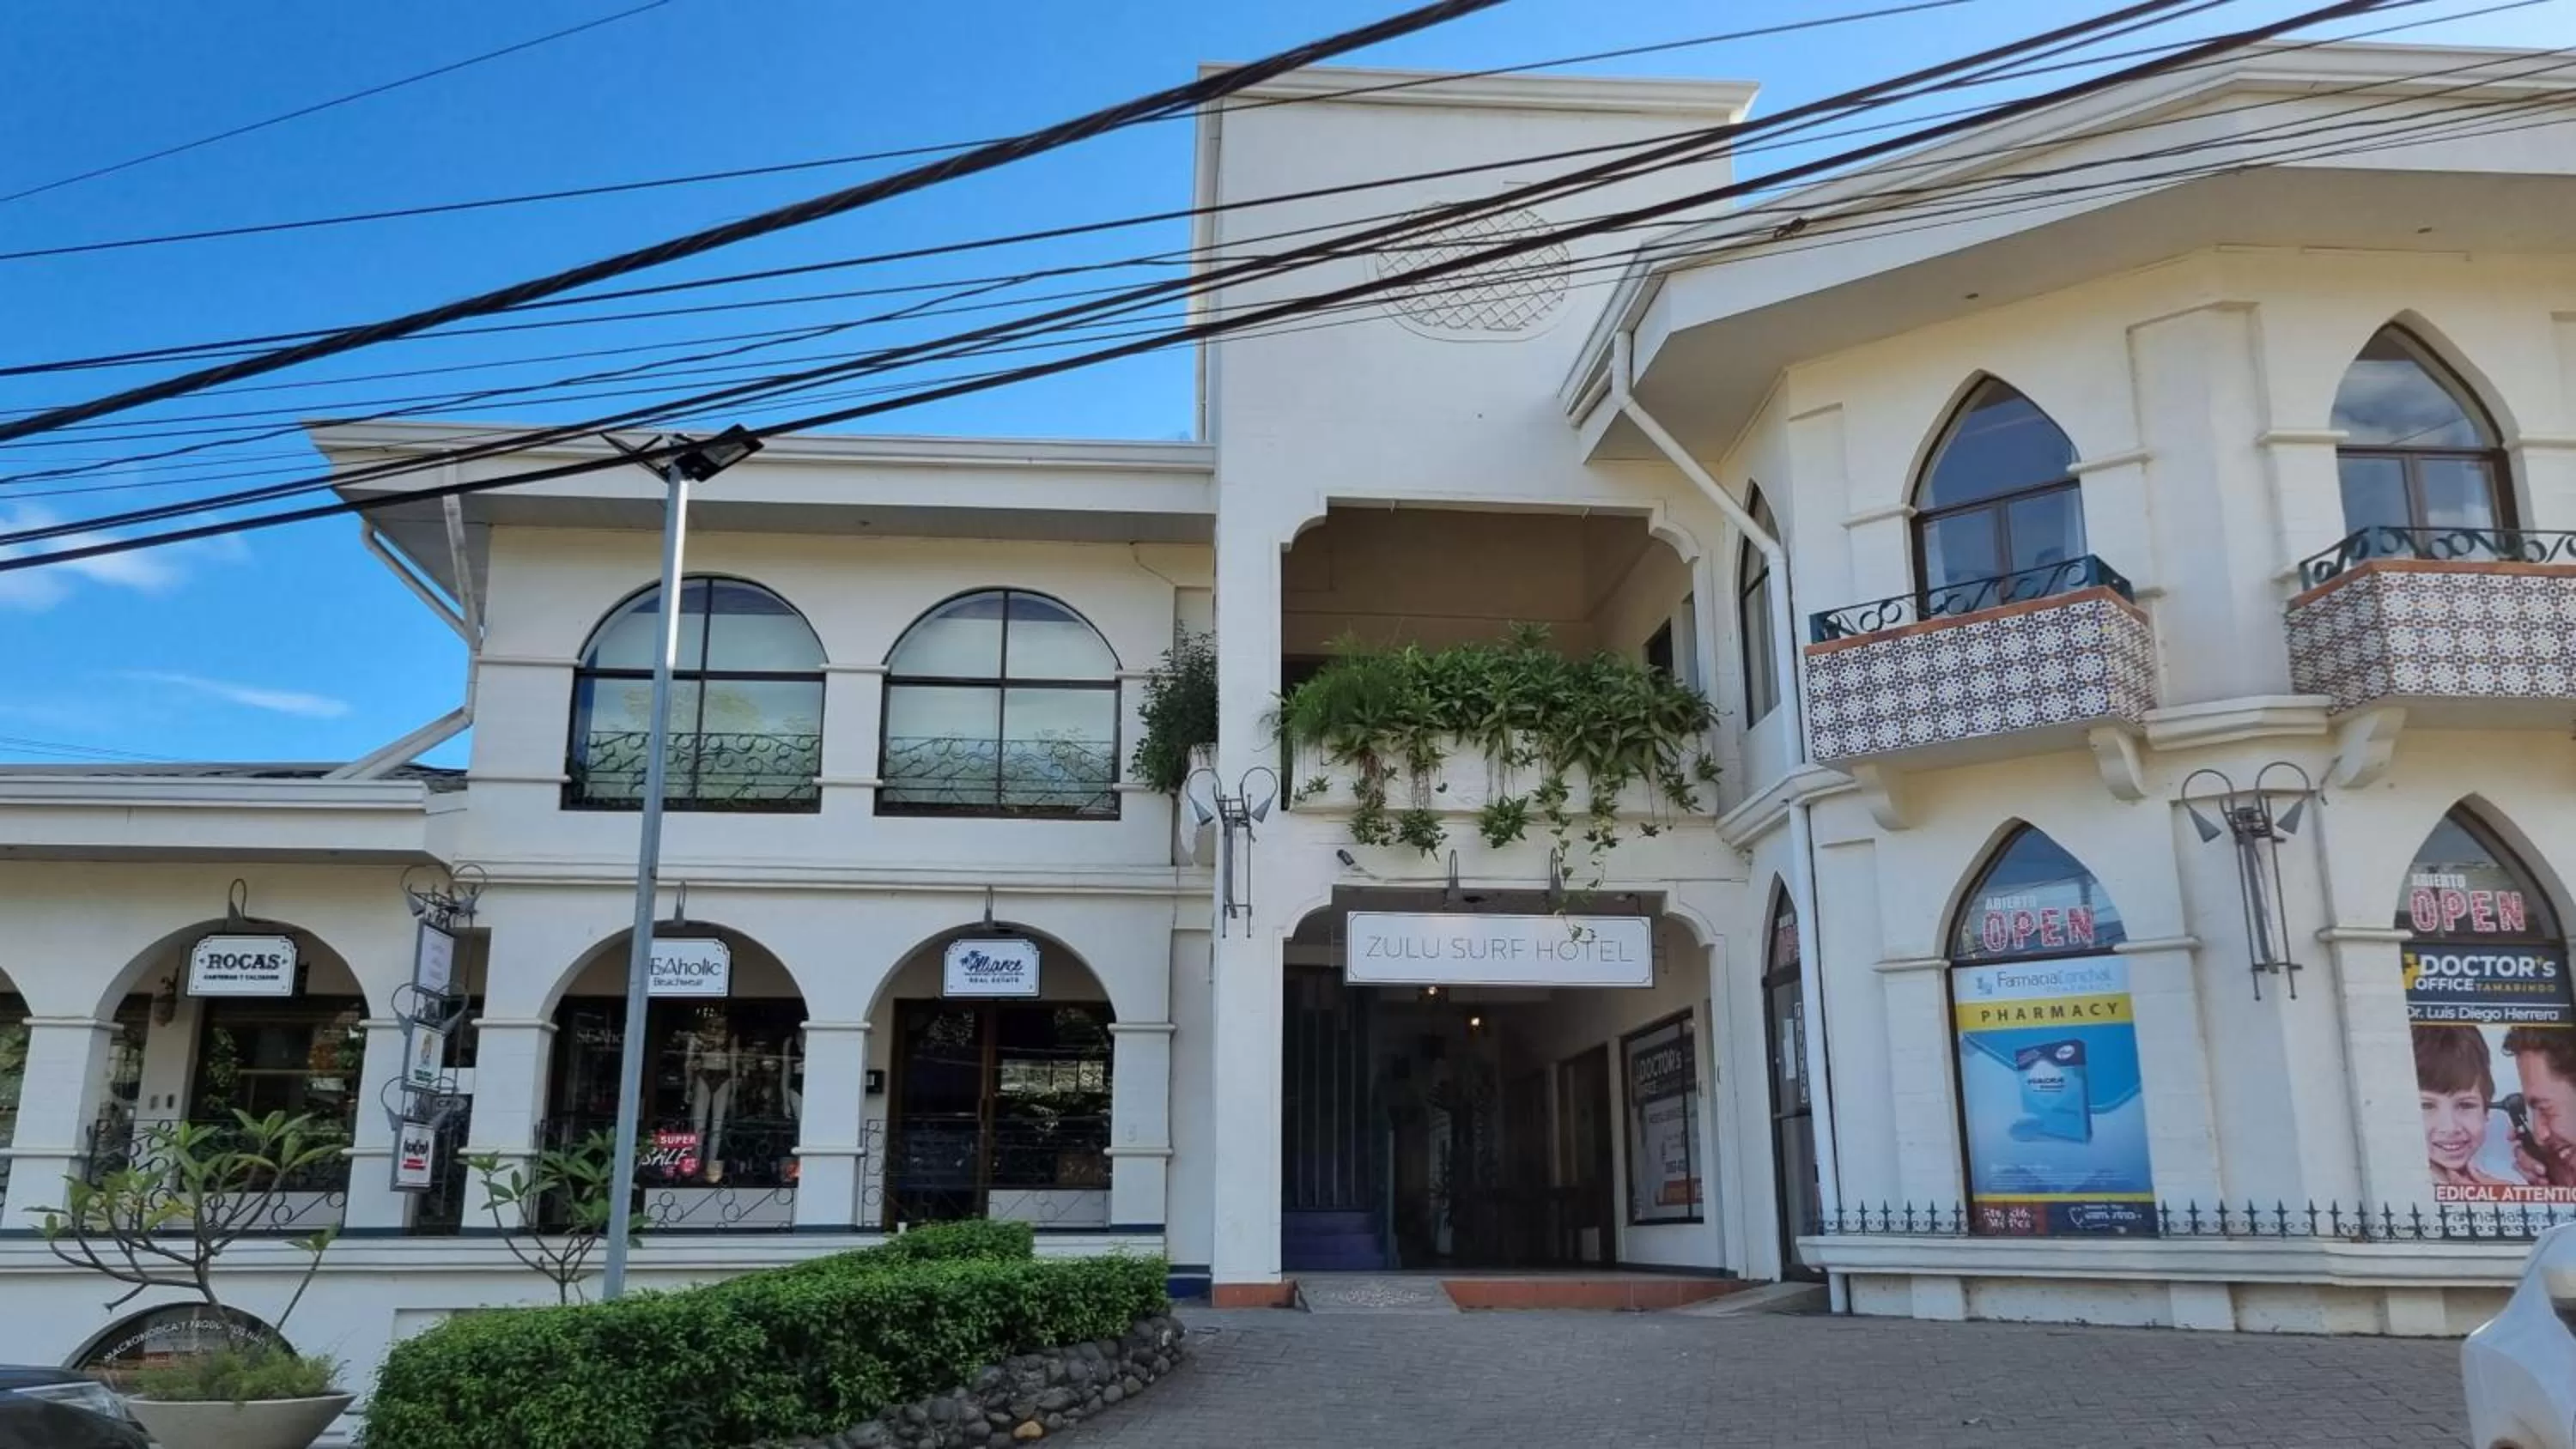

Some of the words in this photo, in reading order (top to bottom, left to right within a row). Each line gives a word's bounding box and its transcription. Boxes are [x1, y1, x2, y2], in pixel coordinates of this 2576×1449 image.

[1984, 895, 2038, 911] ABIERTO
[2409, 888, 2526, 932] OPEN
[1982, 906, 2095, 952] OPEN
[1366, 935, 1441, 959] ZULU
[1451, 937, 1526, 961] SURF
[1536, 939, 1635, 962] HOTEL
[206, 953, 281, 970] ROCAS
[650, 956, 722, 976] EAholic
[2415, 978, 2474, 991] OFFICE
[1981, 1002, 2118, 1022] PHARMACY
[2427, 1006, 2455, 1019] Luis
[2458, 1007, 2501, 1022] Diego
[2505, 1008, 2559, 1022] Herrera
[660, 1135, 696, 1144] SUPER
[641, 1147, 693, 1166] SALE
[2436, 1185, 2498, 1201] EDICAL
[2501, 1185, 2576, 1202] ATTENTI
